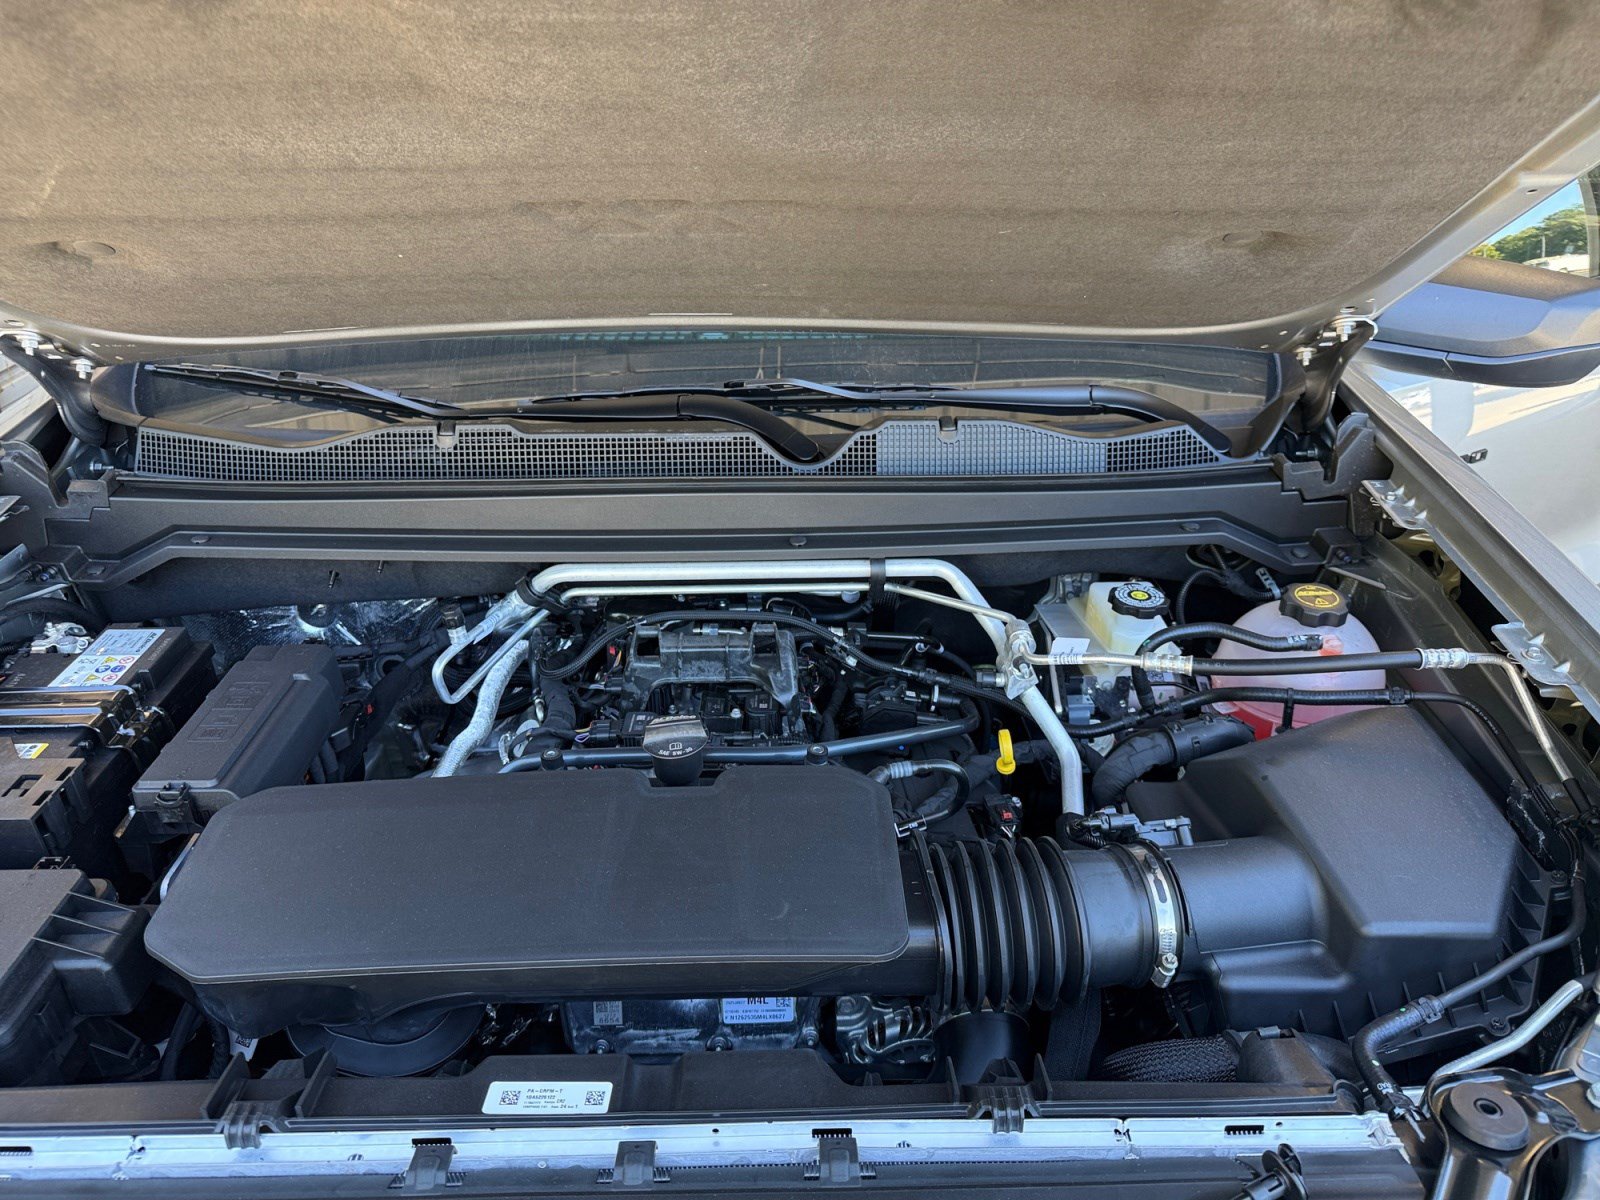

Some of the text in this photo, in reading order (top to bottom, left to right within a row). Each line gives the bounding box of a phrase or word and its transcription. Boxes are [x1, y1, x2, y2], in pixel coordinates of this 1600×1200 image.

[650, 714, 696, 724] ACDelco
[672, 746, 693, 756] 5W-30
[747, 997, 769, 1005] M4L
